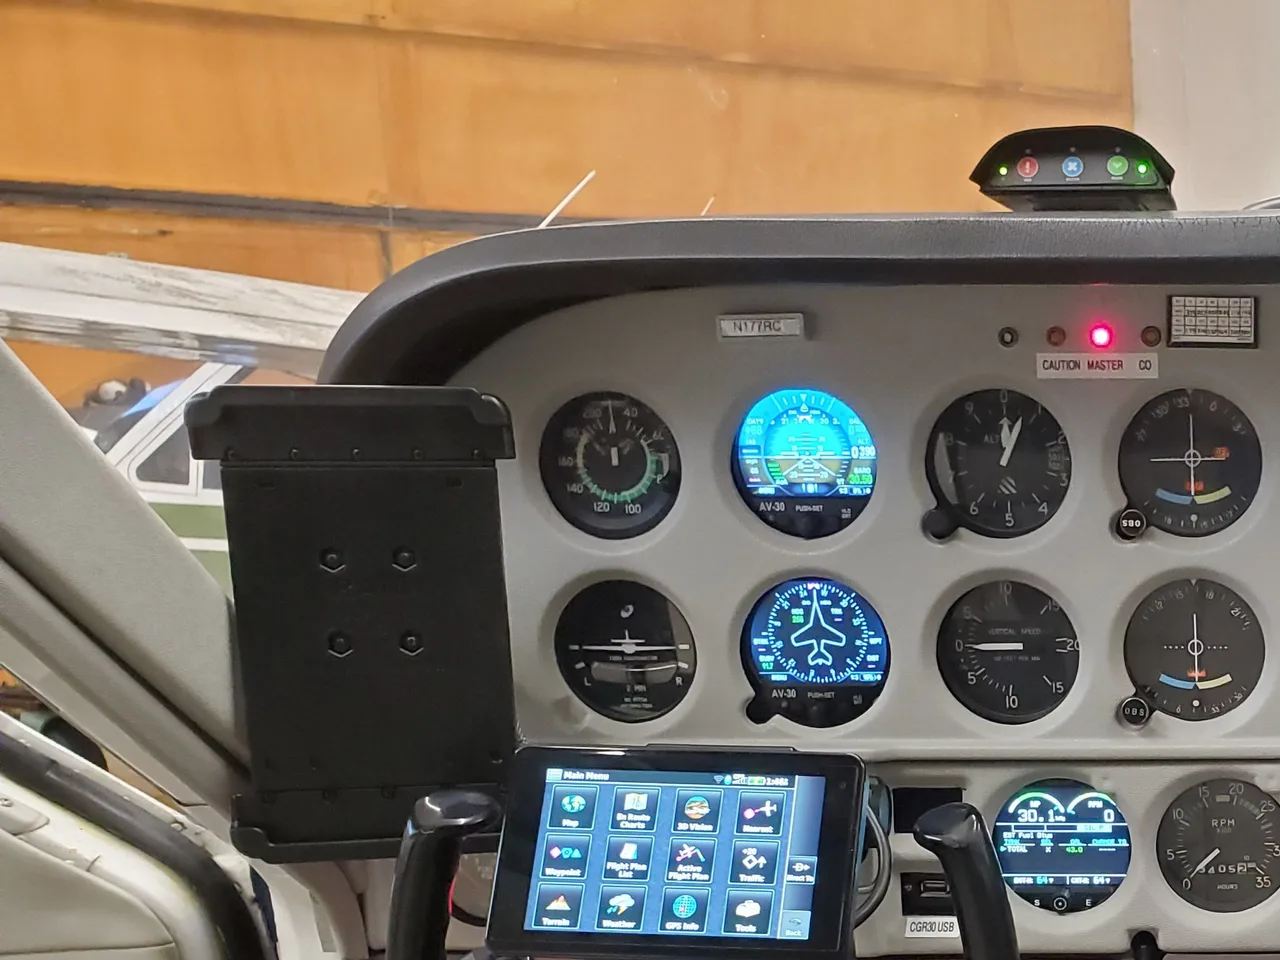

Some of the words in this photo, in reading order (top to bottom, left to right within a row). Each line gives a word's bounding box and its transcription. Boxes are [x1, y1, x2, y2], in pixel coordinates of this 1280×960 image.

[733, 320, 782, 333] N177RC
[1042, 359, 1081, 371] CAUTION
[1087, 359, 1124, 371] MASTER
[1139, 359, 1152, 371] CO
[983, 433, 1000, 444] ALT
[969, 501, 979, 515] 6
[1005, 513, 1015, 527] 5
[1122, 519, 1141, 527] OBS
[675, 676, 683, 686] R
[1052, 681, 1064, 693] 15
[1005, 695, 1019, 709] 10
[563, 771, 584, 780] Main
[585, 771, 610, 781] Menu
[1229, 782, 1245, 795] 20
[1260, 800, 1276, 813] 25
[1172, 807, 1184, 820] 10
[561, 818, 579, 828] Map
[619, 821, 646, 829] Charts
[1211, 819, 1235, 828] RPM
[742, 824, 774, 833] Nearest
[1007, 845, 1029, 853] TOTAL
[1166, 848, 1175, 861] 5
[606, 861, 630, 871] Flight
[630, 862, 648, 871] Plan
[676, 864, 703, 872] Active
[544, 867, 582, 877] Waypoint
[618, 870, 634, 878] List
[668, 871, 691, 881] Flight
[692, 872, 710, 881] Plan
[738, 873, 766, 883] Traffic
[1255, 876, 1272, 889] 35
[1217, 883, 1238, 891] HOURS
[1034, 899, 1040, 907] S
[1085, 899, 1092, 907] E
[541, 917, 570, 927] Terrain
[602, 919, 636, 929] Weather
[665, 921, 682, 930] GPS
[683, 921, 700, 931] Info
[909, 921, 936, 932] CGR30
[937, 921, 955, 932] USB
[735, 923, 757, 933] Tools
[785, 929, 803, 937] Back
